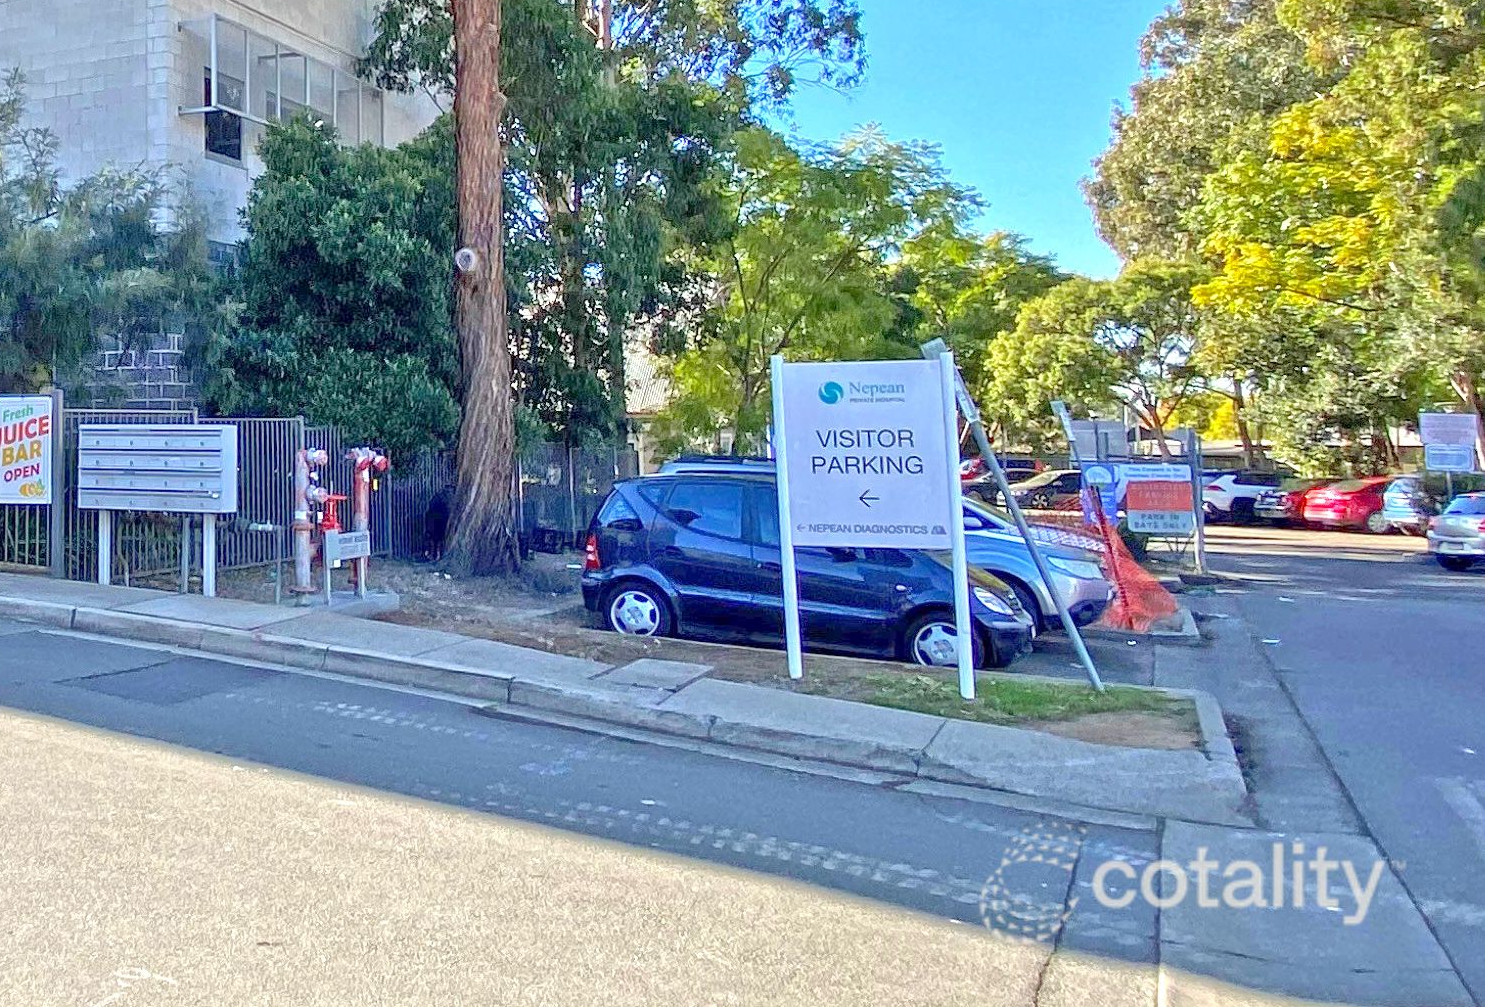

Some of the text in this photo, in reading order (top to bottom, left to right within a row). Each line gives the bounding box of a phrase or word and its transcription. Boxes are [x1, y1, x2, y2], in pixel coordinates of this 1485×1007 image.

[849, 381, 905, 396] Nepean
[2, 404, 34, 423] Fresh
[815, 428, 915, 448] VISITOR
[1, 439, 42, 467] BAR
[3, 463, 41, 482] OPEN
[811, 455, 924, 475] PARKING
[808, 523, 929, 535] NEPEAN DIAGNOSTICS
